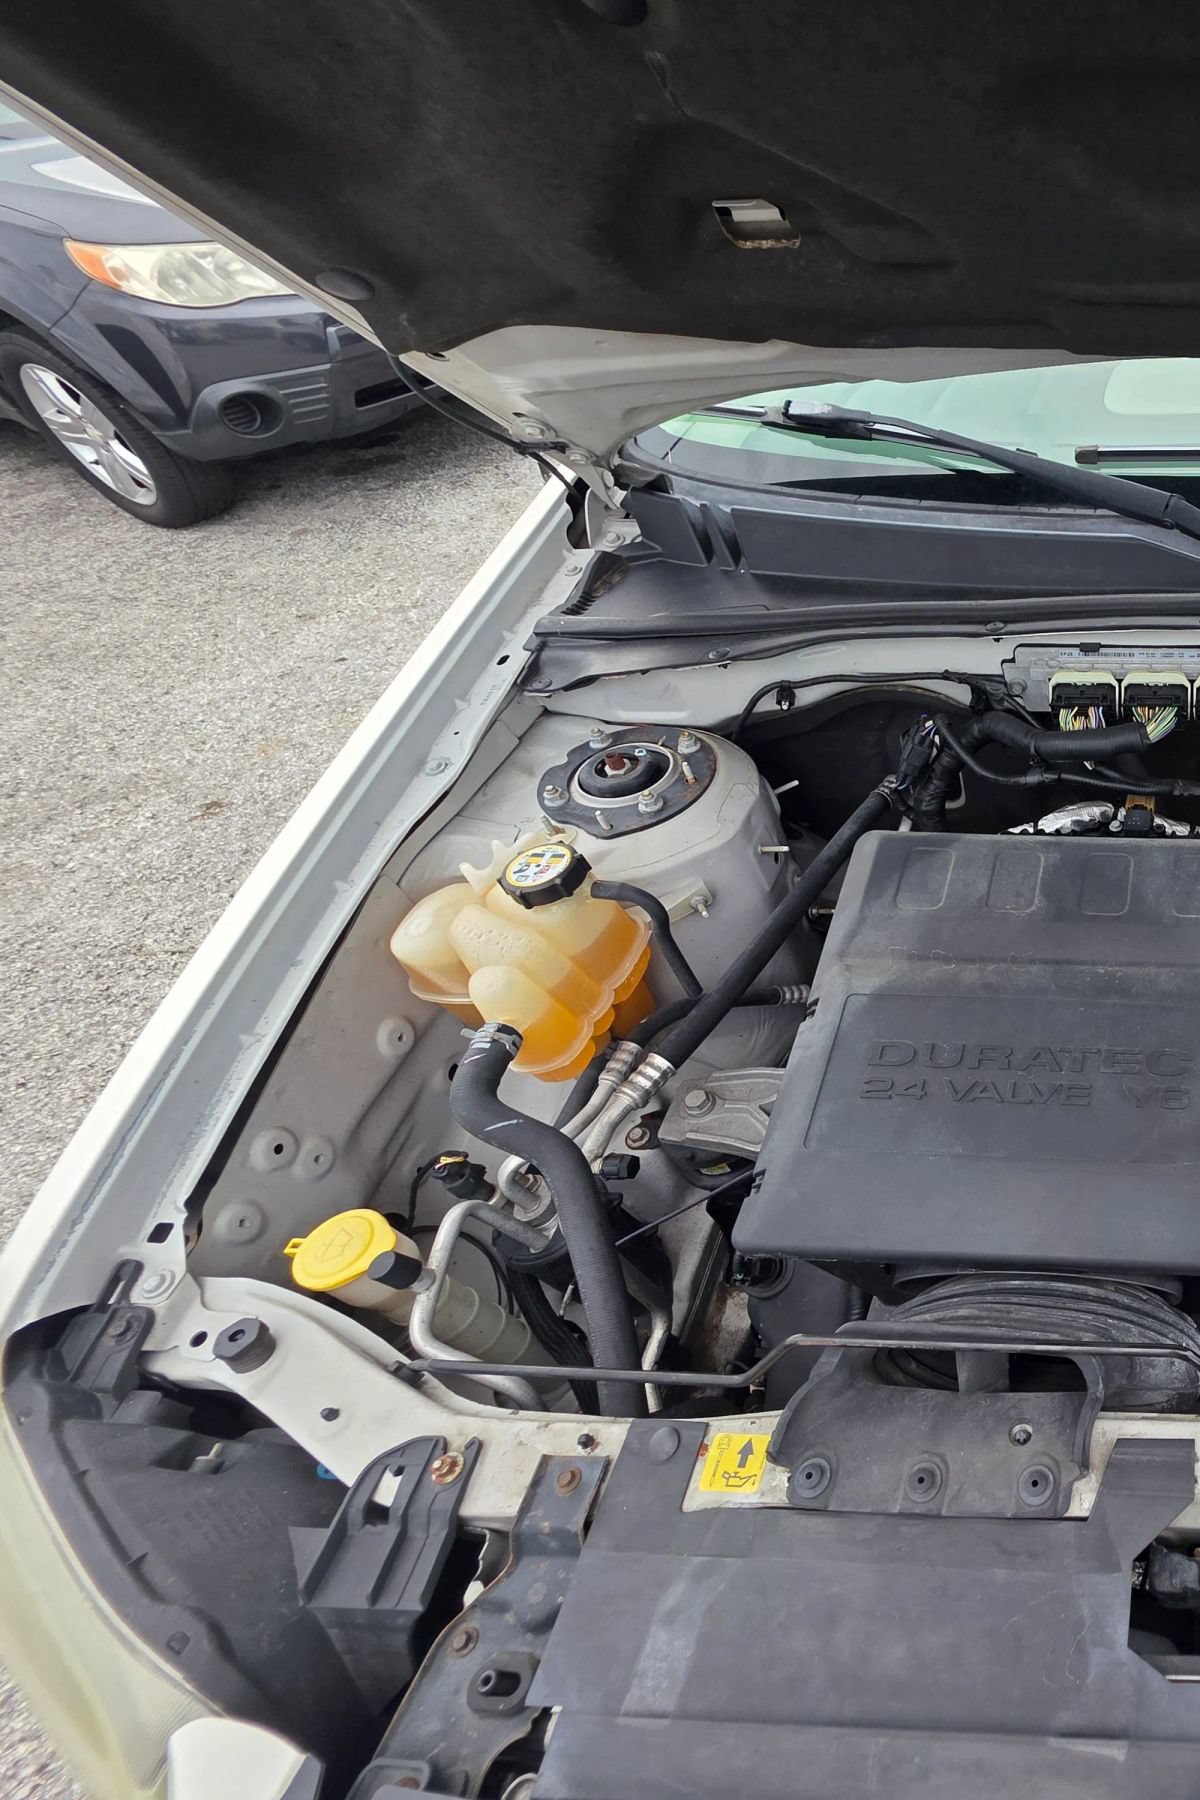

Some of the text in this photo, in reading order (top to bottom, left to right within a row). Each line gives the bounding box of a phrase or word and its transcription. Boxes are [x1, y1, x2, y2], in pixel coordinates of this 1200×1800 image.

[867, 1040, 1193, 1077] DURATEC
[859, 1078, 1192, 1111] 24 VALVE V6
